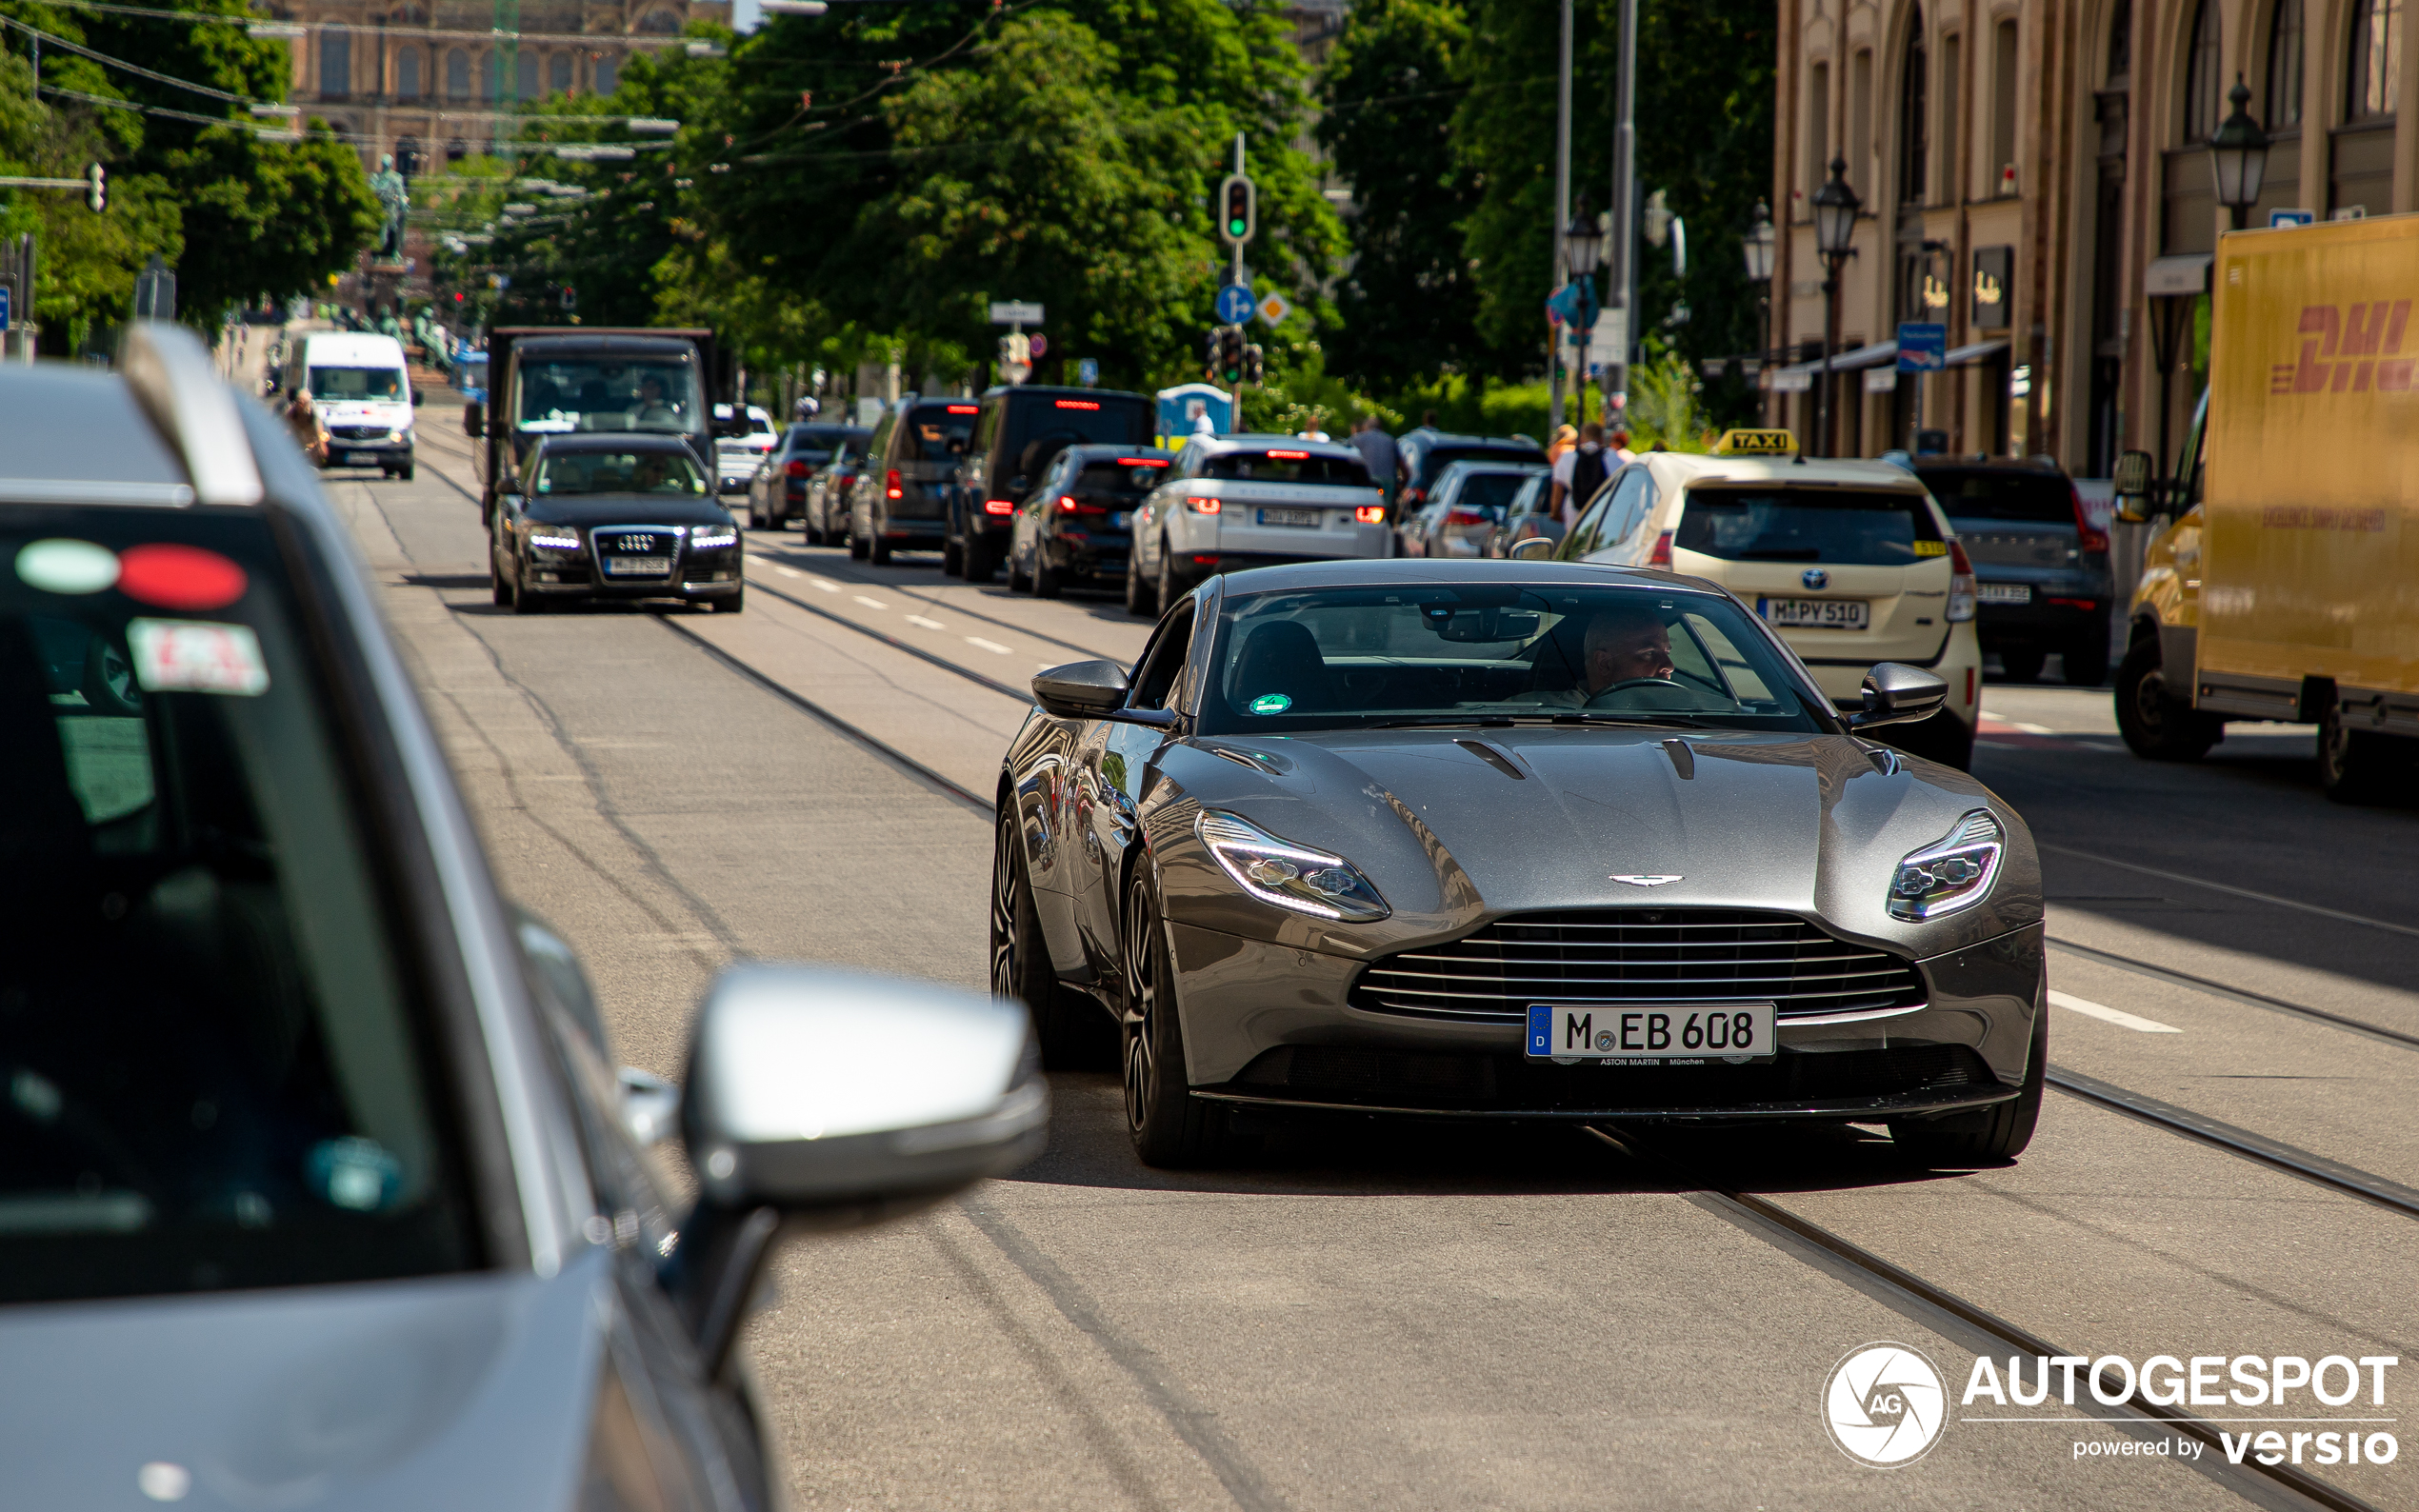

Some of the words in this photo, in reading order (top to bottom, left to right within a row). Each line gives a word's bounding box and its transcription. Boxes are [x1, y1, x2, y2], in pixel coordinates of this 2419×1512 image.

[2291, 299, 2417, 393] DHL
[1734, 434, 1786, 448] TAXI
[1775, 603, 1788, 619] M
[1800, 603, 1822, 621] PY
[1826, 604, 1859, 622] 510
[1536, 1036, 1545, 1046] D
[1567, 1012, 1591, 1049] M
[1621, 1013, 1671, 1050] EB
[1682, 1012, 1753, 1049] 608
